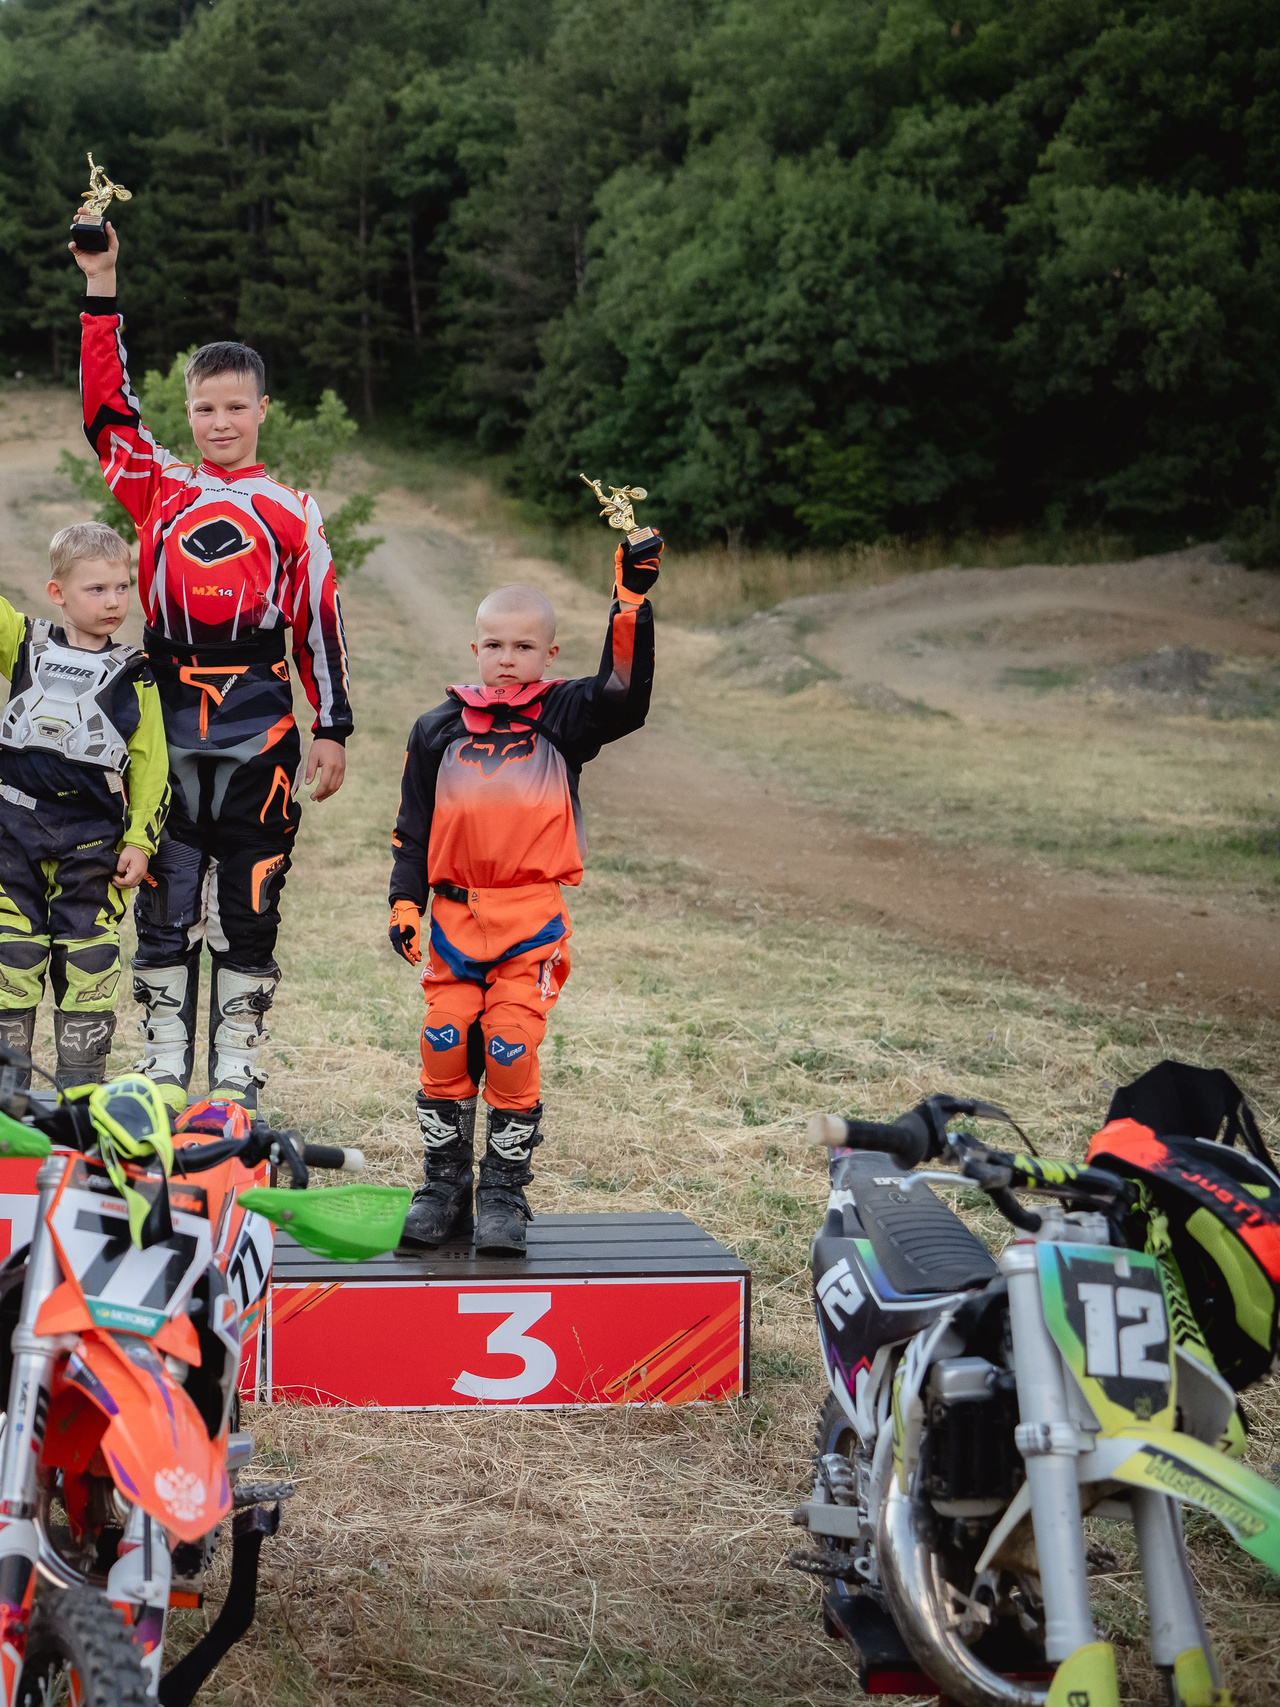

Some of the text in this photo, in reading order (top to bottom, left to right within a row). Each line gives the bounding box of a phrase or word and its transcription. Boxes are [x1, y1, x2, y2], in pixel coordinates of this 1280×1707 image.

[192, 585, 234, 597] MX14
[44, 661, 95, 679] THOR
[46, 671, 85, 683] RACING
[74, 1208, 199, 1311] 77
[229, 1229, 265, 1310] 77
[815, 1257, 866, 1332] 12
[108, 1309, 159, 1329] MOTOREX
[451, 1292, 558, 1400] 3
[1077, 1282, 1170, 1382] 12
